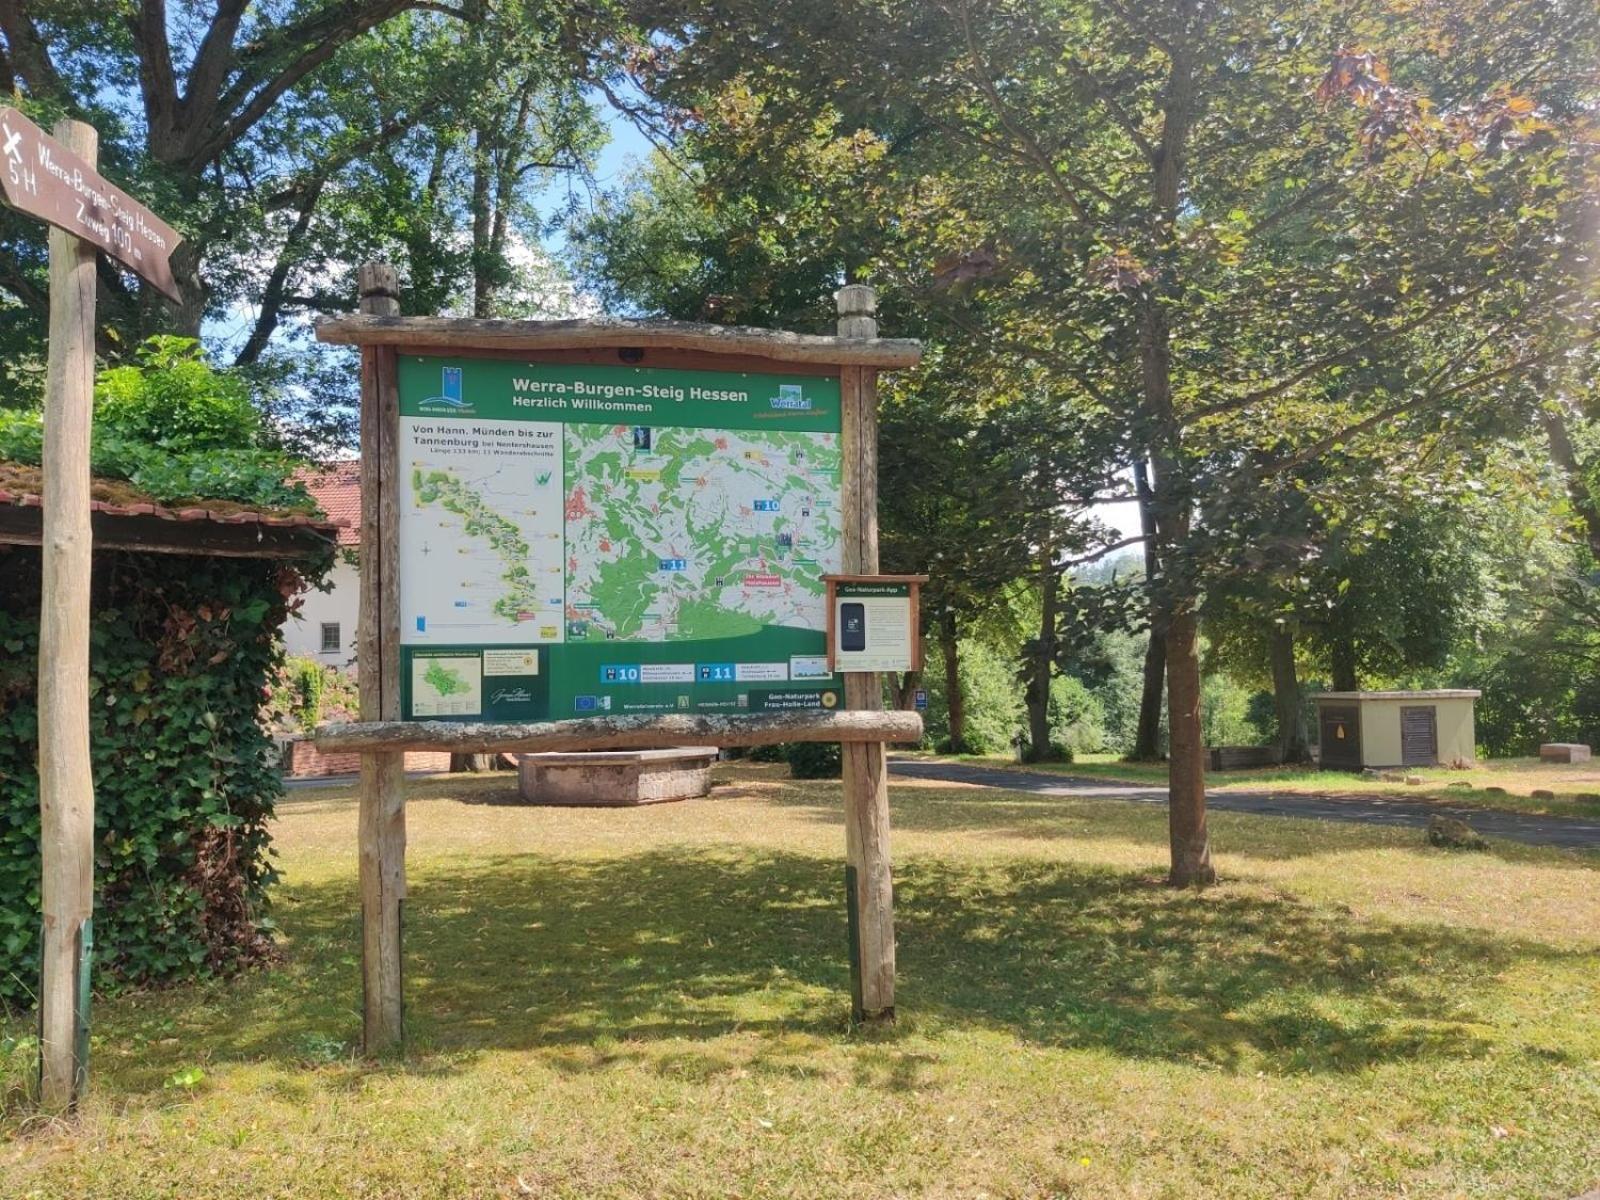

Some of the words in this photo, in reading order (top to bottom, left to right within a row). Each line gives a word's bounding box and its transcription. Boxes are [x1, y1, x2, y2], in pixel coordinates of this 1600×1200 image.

[74, 198, 110, 243] Zuweg
[136, 213, 166, 249] Hessen
[512, 378, 684, 402] Werra-Burgen-Steig
[689, 386, 749, 402] Hessen
[512, 396, 567, 408] Herzlich
[571, 398, 653, 412] Willkommen
[412, 425, 434, 434] Von
[437, 426, 469, 436] Hann.
[472, 427, 515, 437] Münden
[518, 429, 534, 438] bis
[413, 437, 479, 448] Tannenburg
[618, 668, 639, 681] 10
[714, 667, 733, 680] 11
